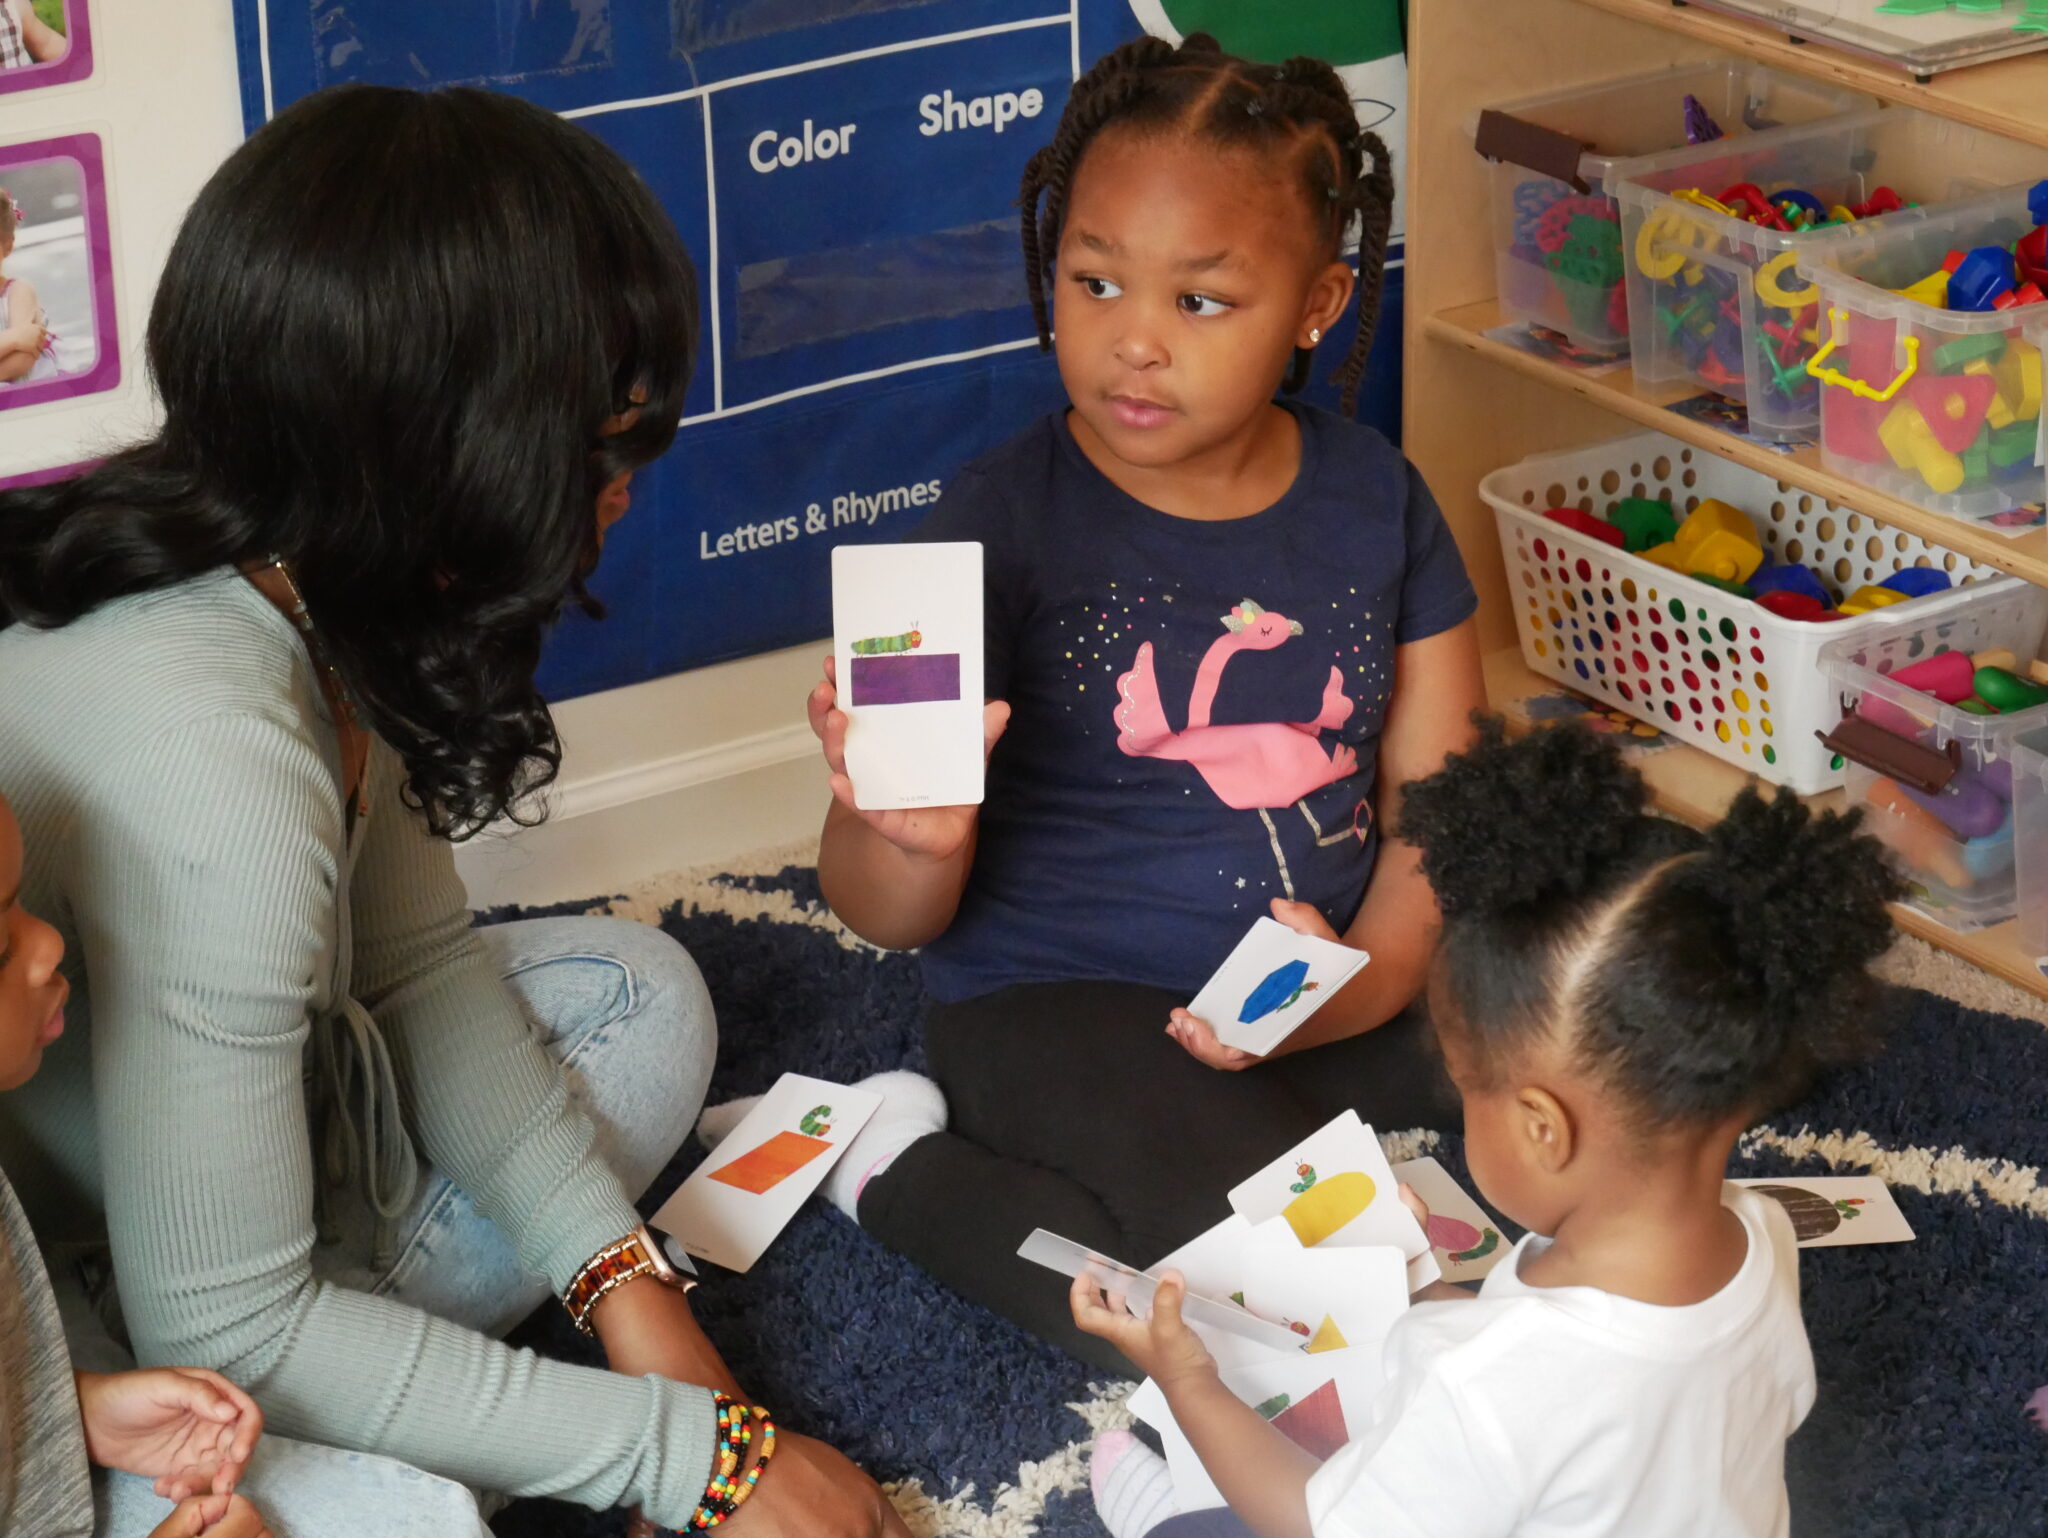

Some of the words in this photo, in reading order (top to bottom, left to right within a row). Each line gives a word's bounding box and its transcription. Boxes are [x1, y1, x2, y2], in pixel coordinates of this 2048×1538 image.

[749, 119, 857, 173] Color
[918, 88, 1044, 136] Shape
[700, 515, 799, 560] Letters
[804, 503, 828, 535] &
[832, 479, 942, 527] Rhymes
